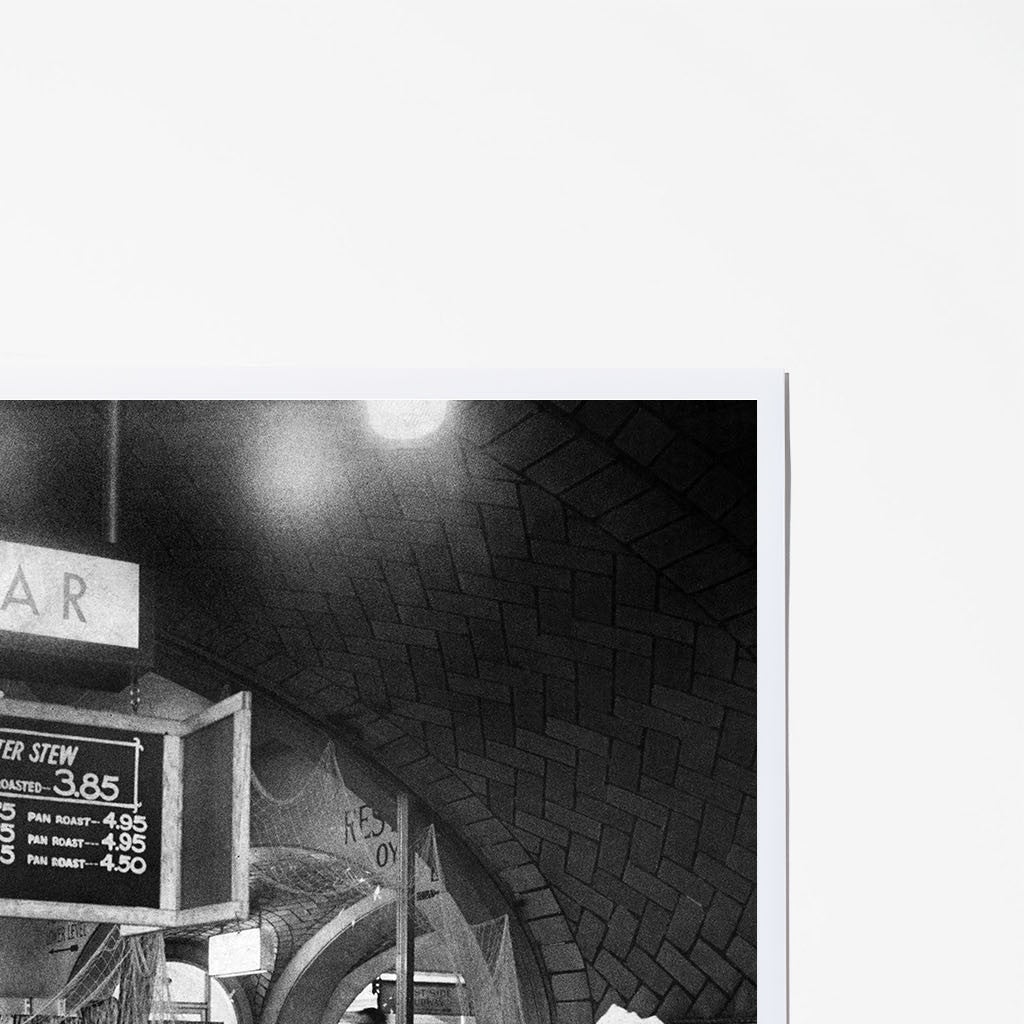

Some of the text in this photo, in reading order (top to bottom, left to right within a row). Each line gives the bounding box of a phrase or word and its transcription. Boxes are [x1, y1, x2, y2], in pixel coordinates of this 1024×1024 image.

[29, 742, 79, 767] STEW
[53, 768, 119, 802] 3.85
[27, 811, 148, 833] PAN ROAST 4.95
[27, 832, 147, 853] PAN ROAST 4.95
[27, 853, 147, 875] PAN ROAST 4.50
